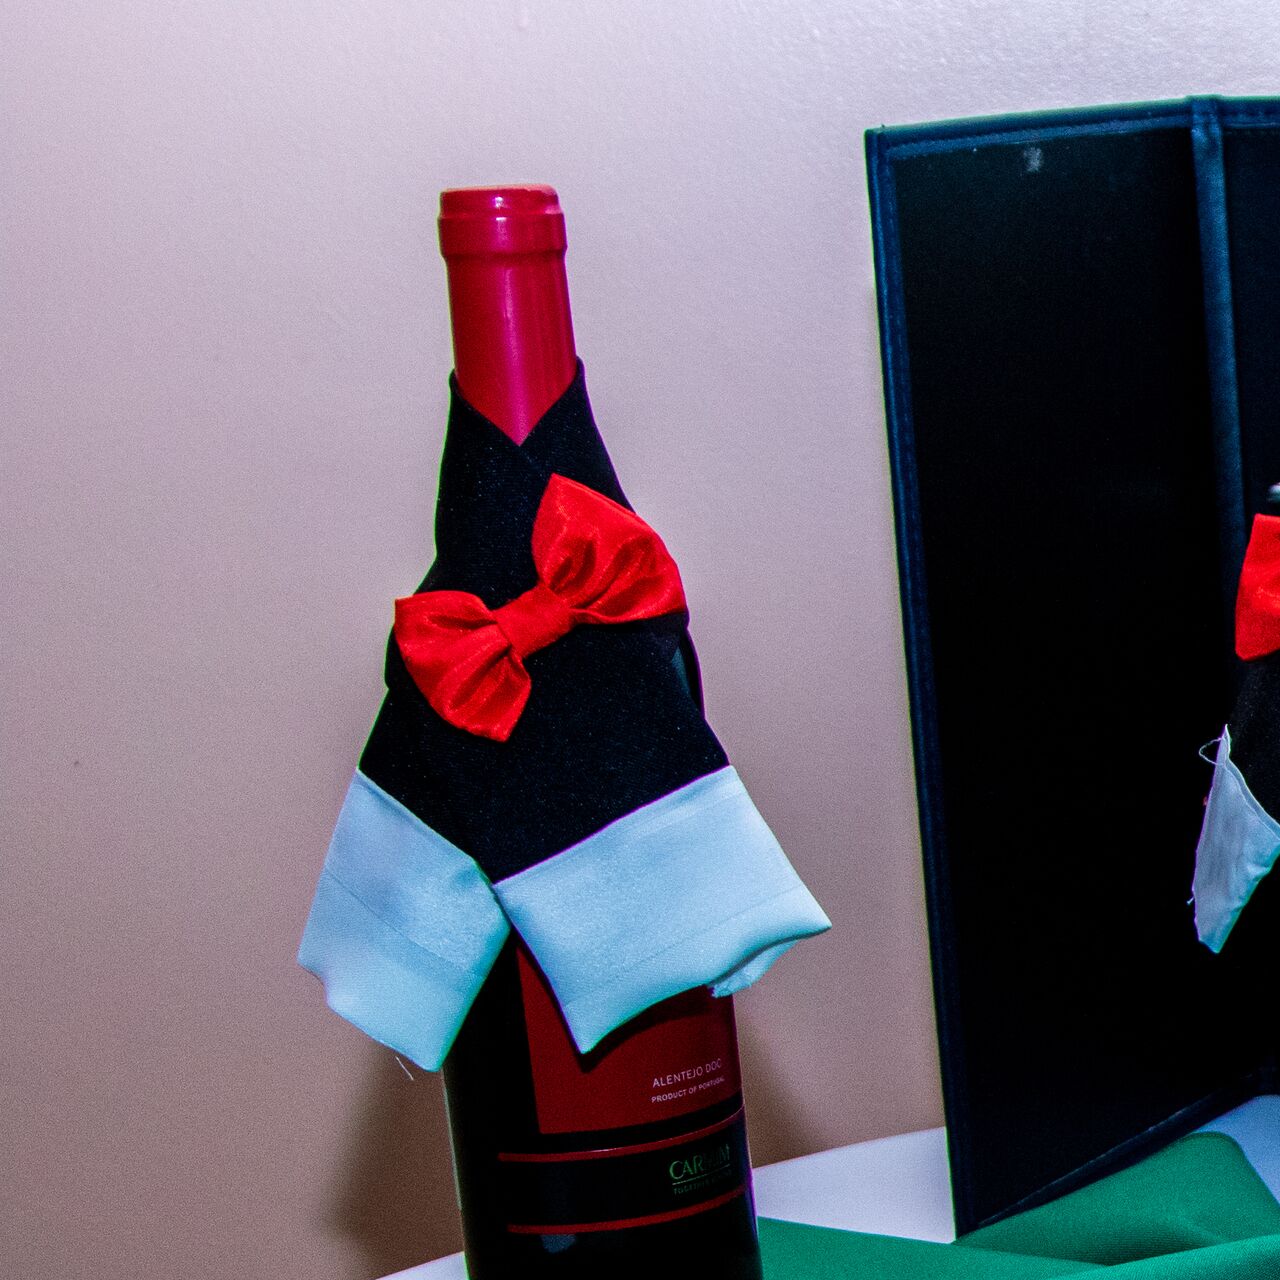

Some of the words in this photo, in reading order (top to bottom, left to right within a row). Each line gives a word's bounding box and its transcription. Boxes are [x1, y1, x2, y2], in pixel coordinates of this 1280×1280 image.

[652, 1066, 704, 1088] ALENTEJO
[705, 1058, 723, 1073] DOC
[651, 1088, 687, 1103] PRODUCT
[688, 1085, 698, 1095] OF
